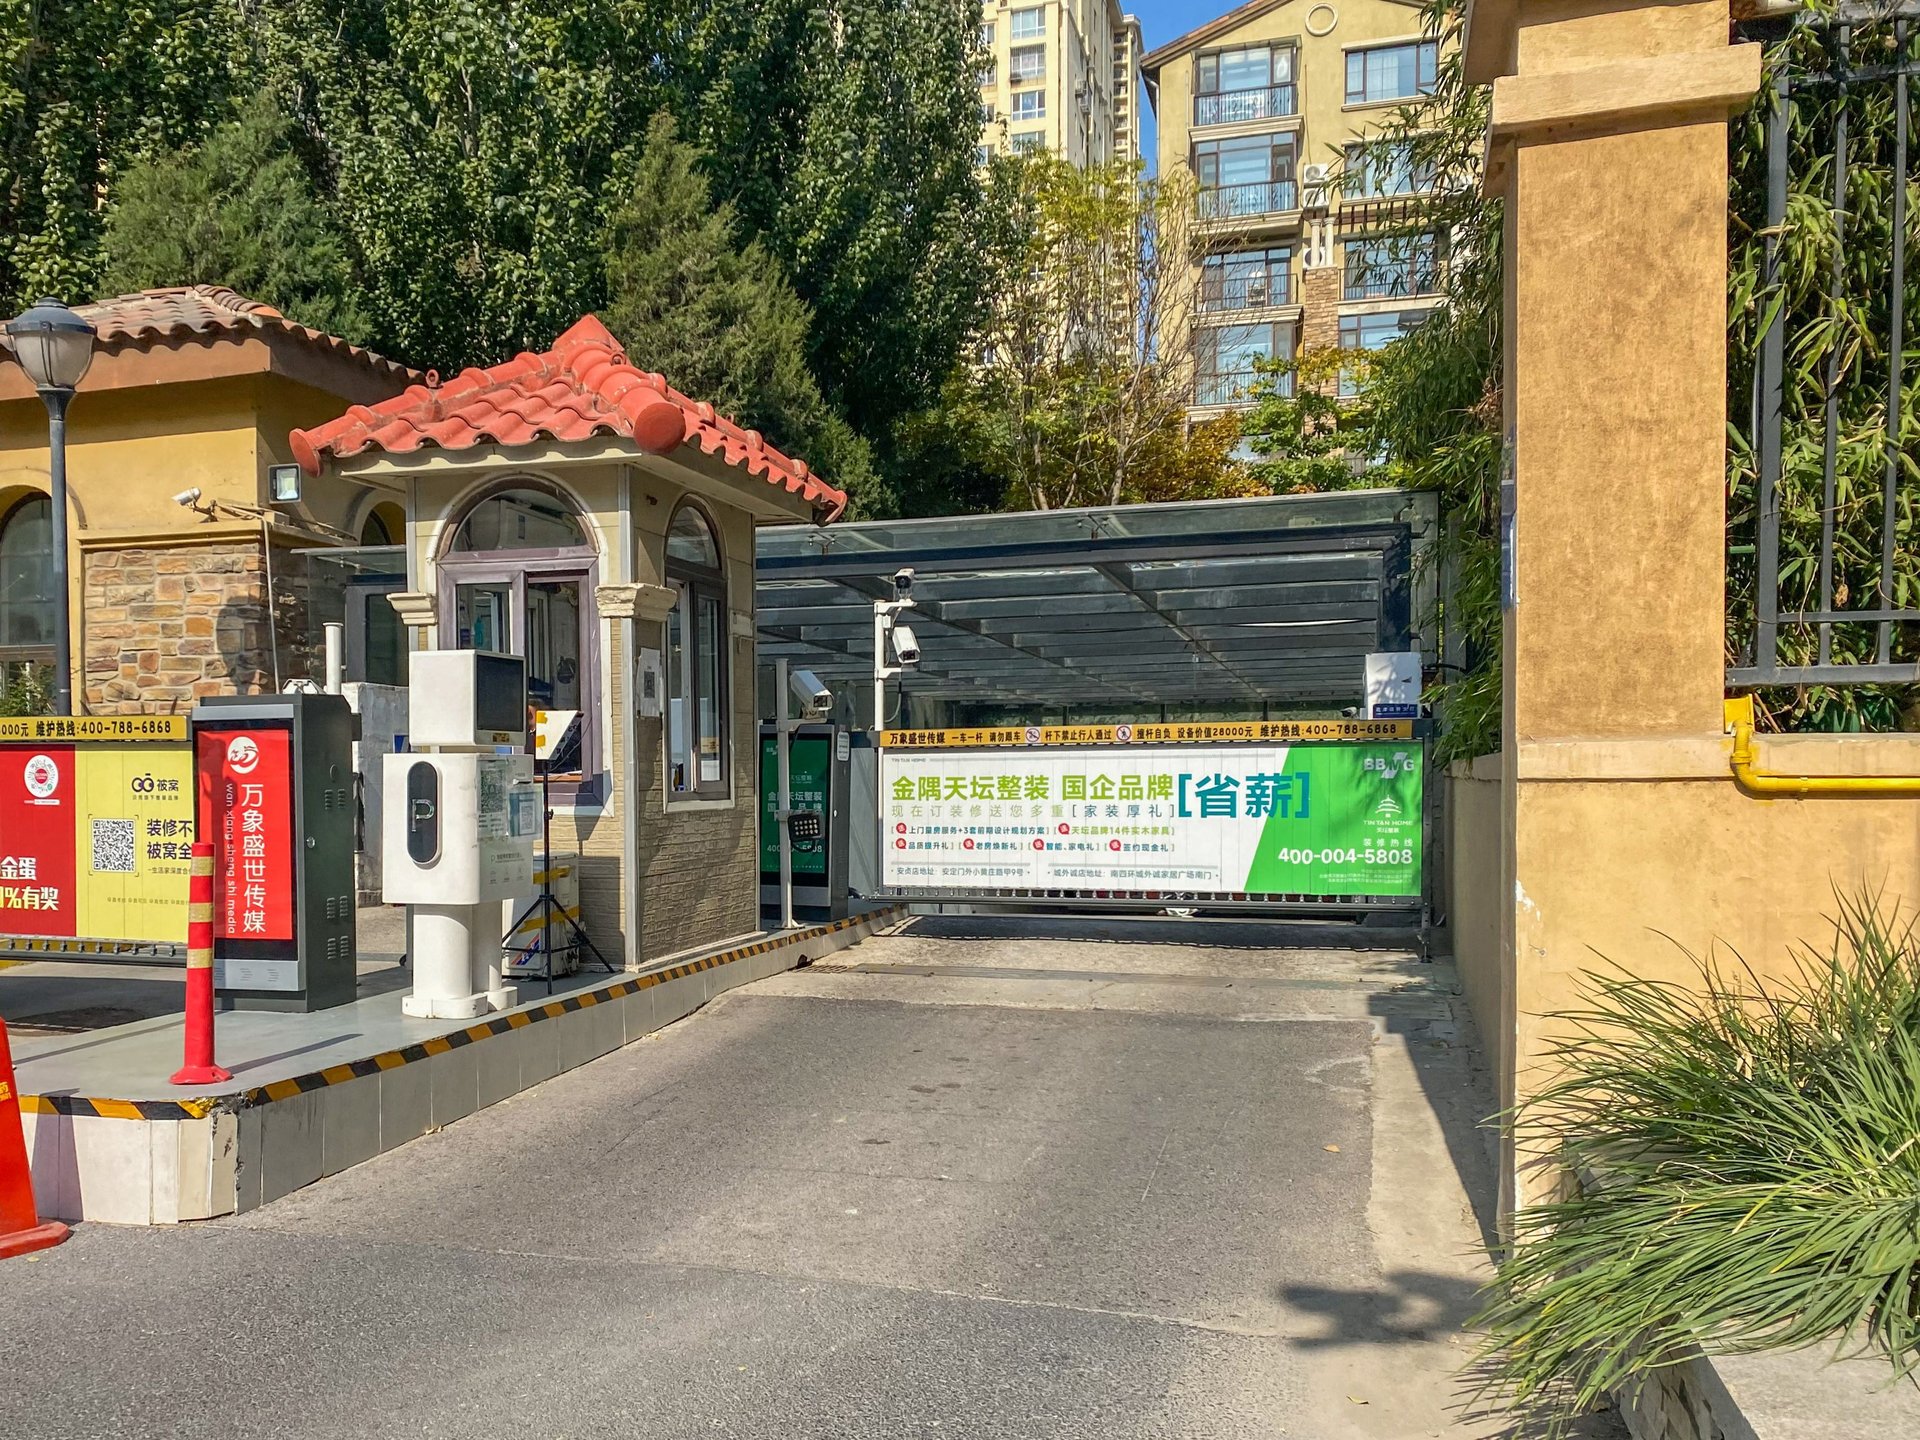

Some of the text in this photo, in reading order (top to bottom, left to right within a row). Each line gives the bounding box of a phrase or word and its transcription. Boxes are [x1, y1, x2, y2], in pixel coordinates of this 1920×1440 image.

[0, 723, 29, 737] 000元
[889, 731, 946, 745] 万象盛世传媒
[951, 732, 984, 744] 一车一杆
[989, 731, 1021, 743] 请勿跟车
[1045, 728, 1112, 742] 杆下禁止行人通过
[1177, 726, 1254, 739] 设备价值28000元
[157, 779, 180, 792] 被窝
[892, 775, 1050, 801] 金隅天坛整装
[1062, 774, 1175, 801] 国企品牌
[147, 818, 193, 838] 装修不
[147, 842, 193, 861] 被窝全
[224, 783, 237, 934] wan xiang sheng shi media
[241, 783, 267, 934] 万象盛世传媒
[1278, 847, 1413, 865] 400-004-5808
